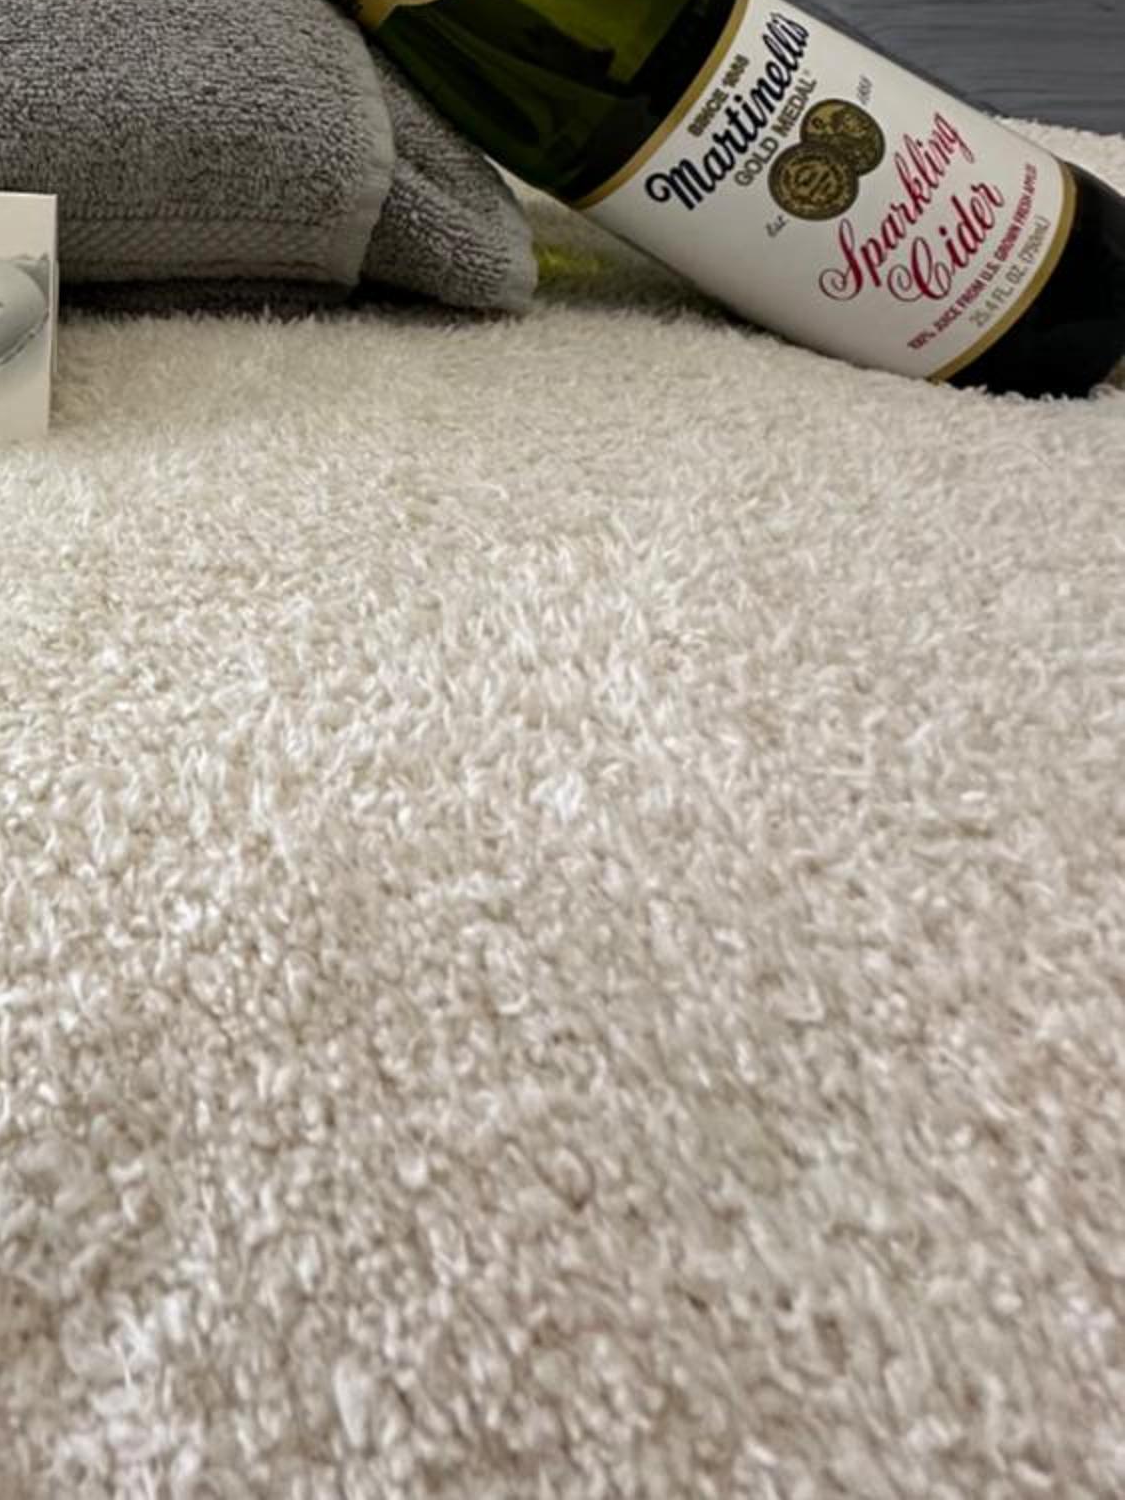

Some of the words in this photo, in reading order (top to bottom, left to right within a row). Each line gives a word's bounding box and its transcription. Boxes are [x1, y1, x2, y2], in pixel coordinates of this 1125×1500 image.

[644, 13, 810, 211] Martinelli's
[733, 136, 779, 187] GOLD
[771, 77, 818, 138] MEDAL
[818, 112, 976, 301] Sparkling
[887, 182, 1005, 302] Cider
[955, 277, 988, 308] FROM
